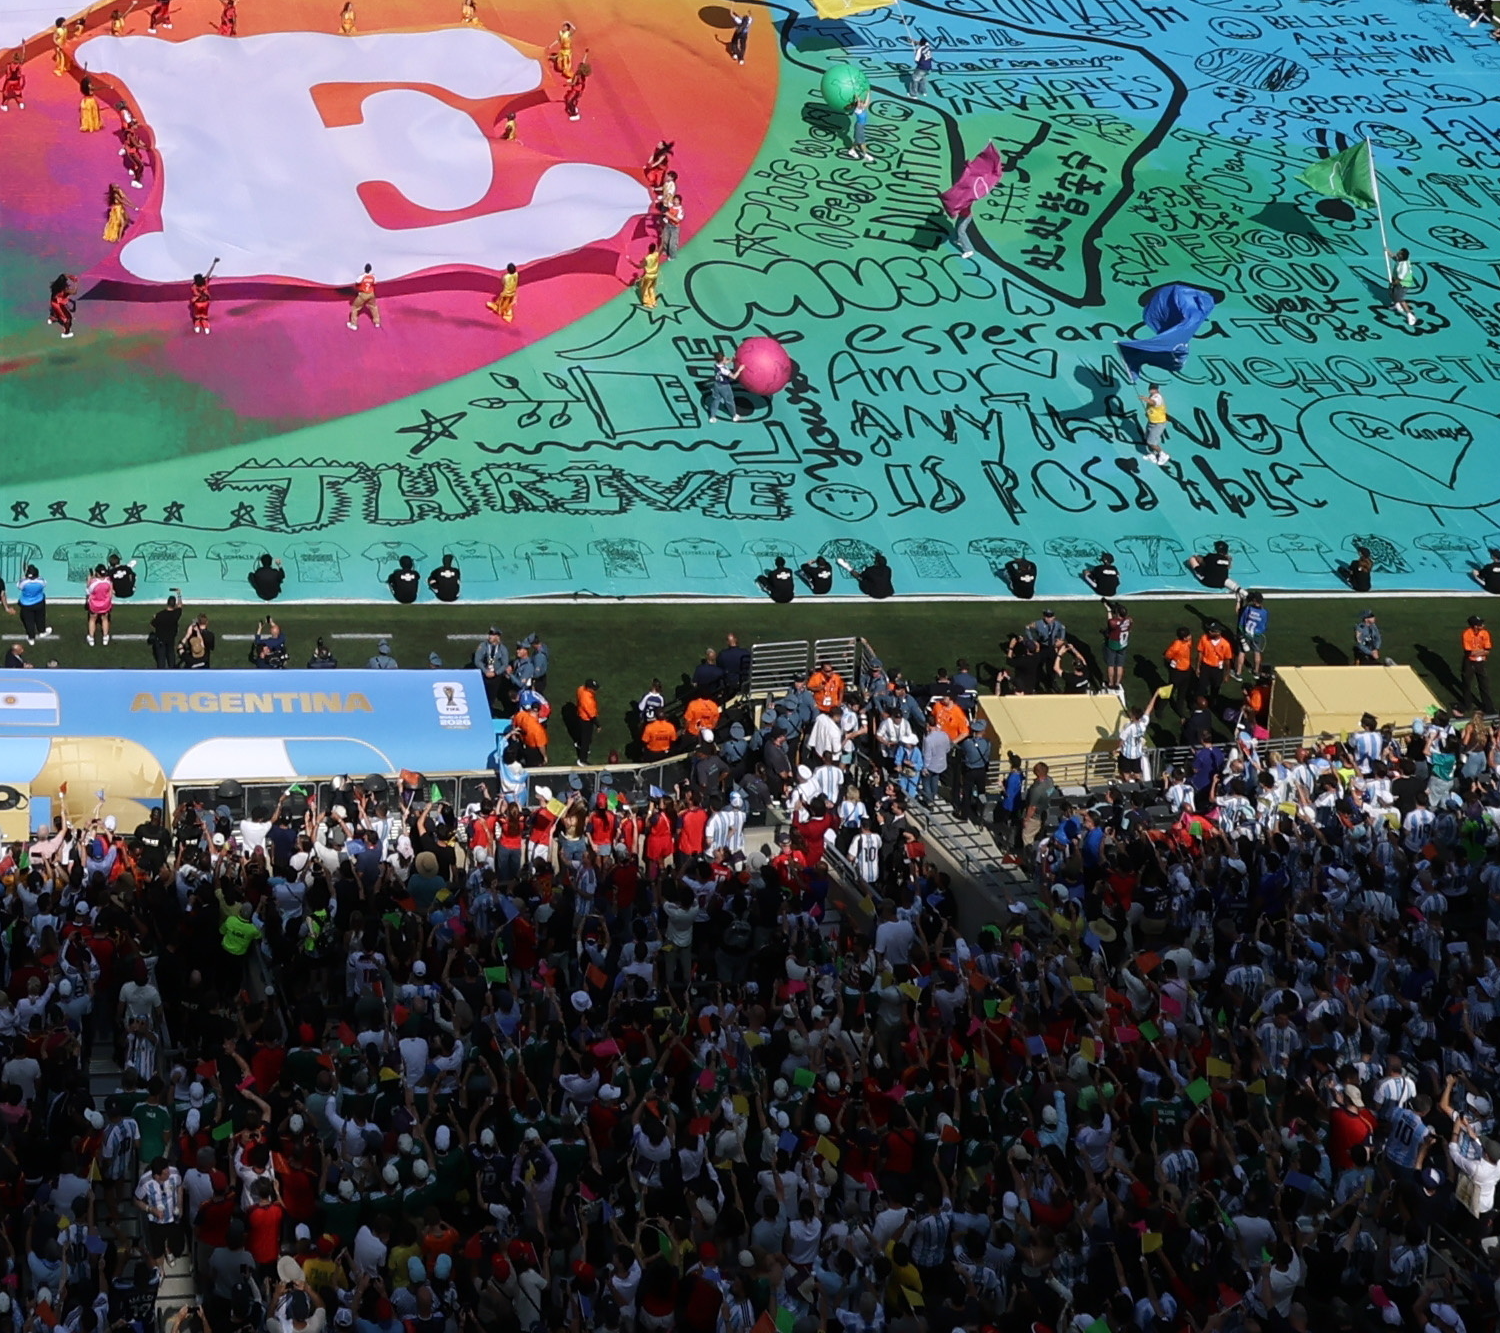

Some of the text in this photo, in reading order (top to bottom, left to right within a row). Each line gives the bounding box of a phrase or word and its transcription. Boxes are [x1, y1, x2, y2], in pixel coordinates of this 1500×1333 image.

[1261, 13, 1397, 29] BELIEVE
[929, 75, 1165, 100] EVERYONE'S
[948, 91, 1160, 116] INVITED
[1132, 232, 1371, 271] PERSON
[1190, 261, 1343, 294] YOU
[1230, 315, 1326, 345] TO
[828, 350, 1003, 401] Amor
[205, 457, 799, 534] THRIVE
[130, 692, 374, 714] ARGENTINA
